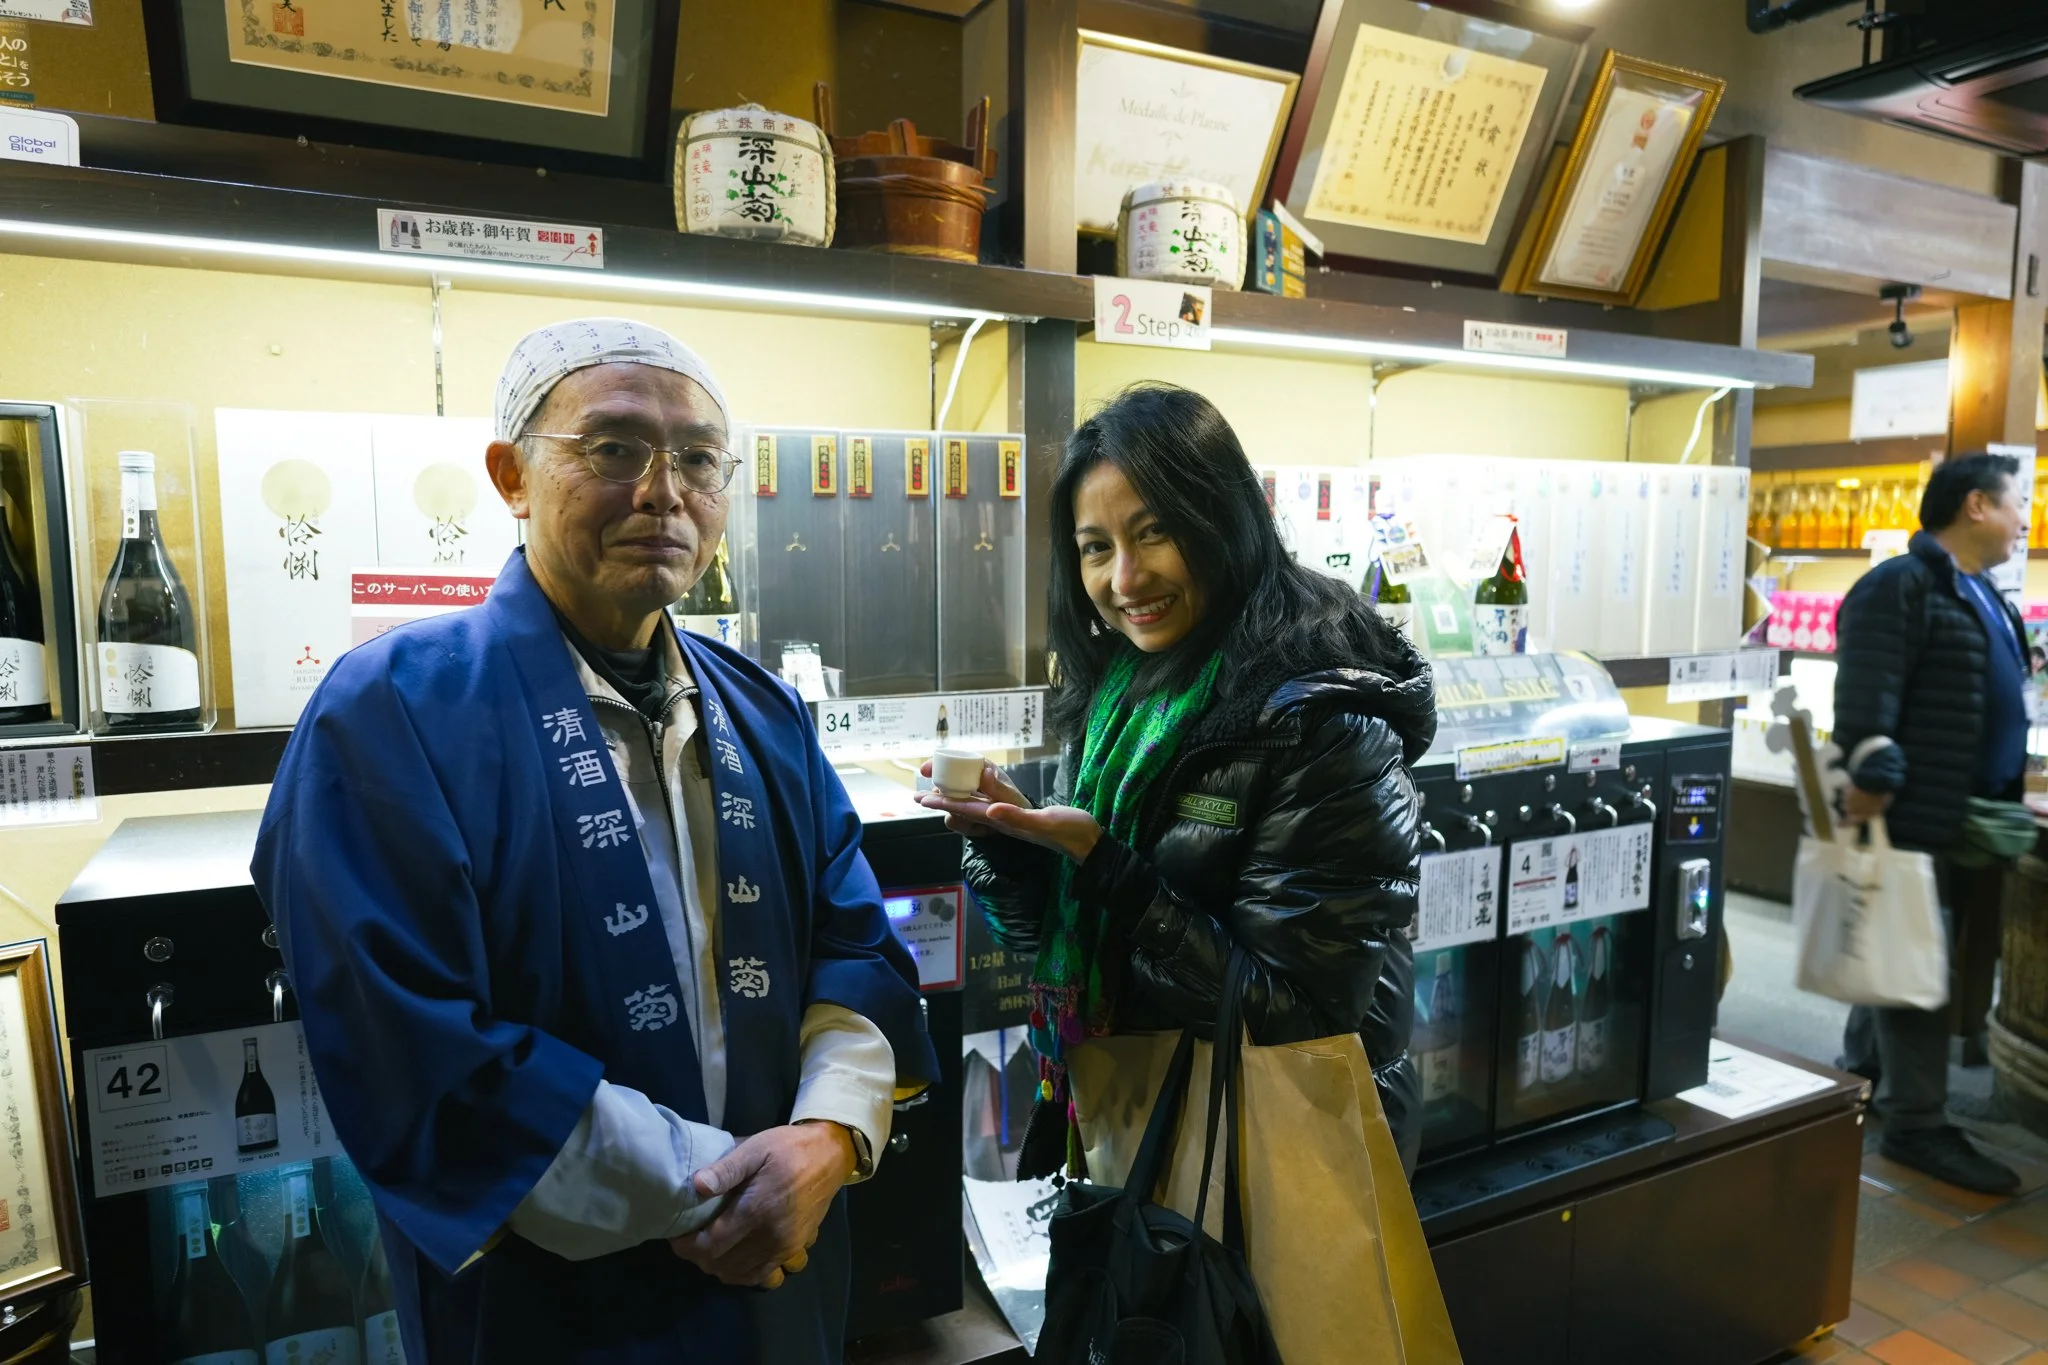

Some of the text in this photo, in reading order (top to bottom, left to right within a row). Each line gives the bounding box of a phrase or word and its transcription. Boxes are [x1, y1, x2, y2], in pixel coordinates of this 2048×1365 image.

[9, 136, 56, 149] Global
[11, 143, 43, 154] Blue
[738, 136, 777, 223] 深山菊
[425, 218, 532, 243] お歳暮・御年賀
[1112, 294, 1134, 335] 2
[1137, 313, 1181, 343] Step
[825, 713, 851, 733] 34
[1203, 800, 1234, 813] KYLIE
[1521, 854, 1531, 874] 4
[106, 1062, 162, 1099] 42
